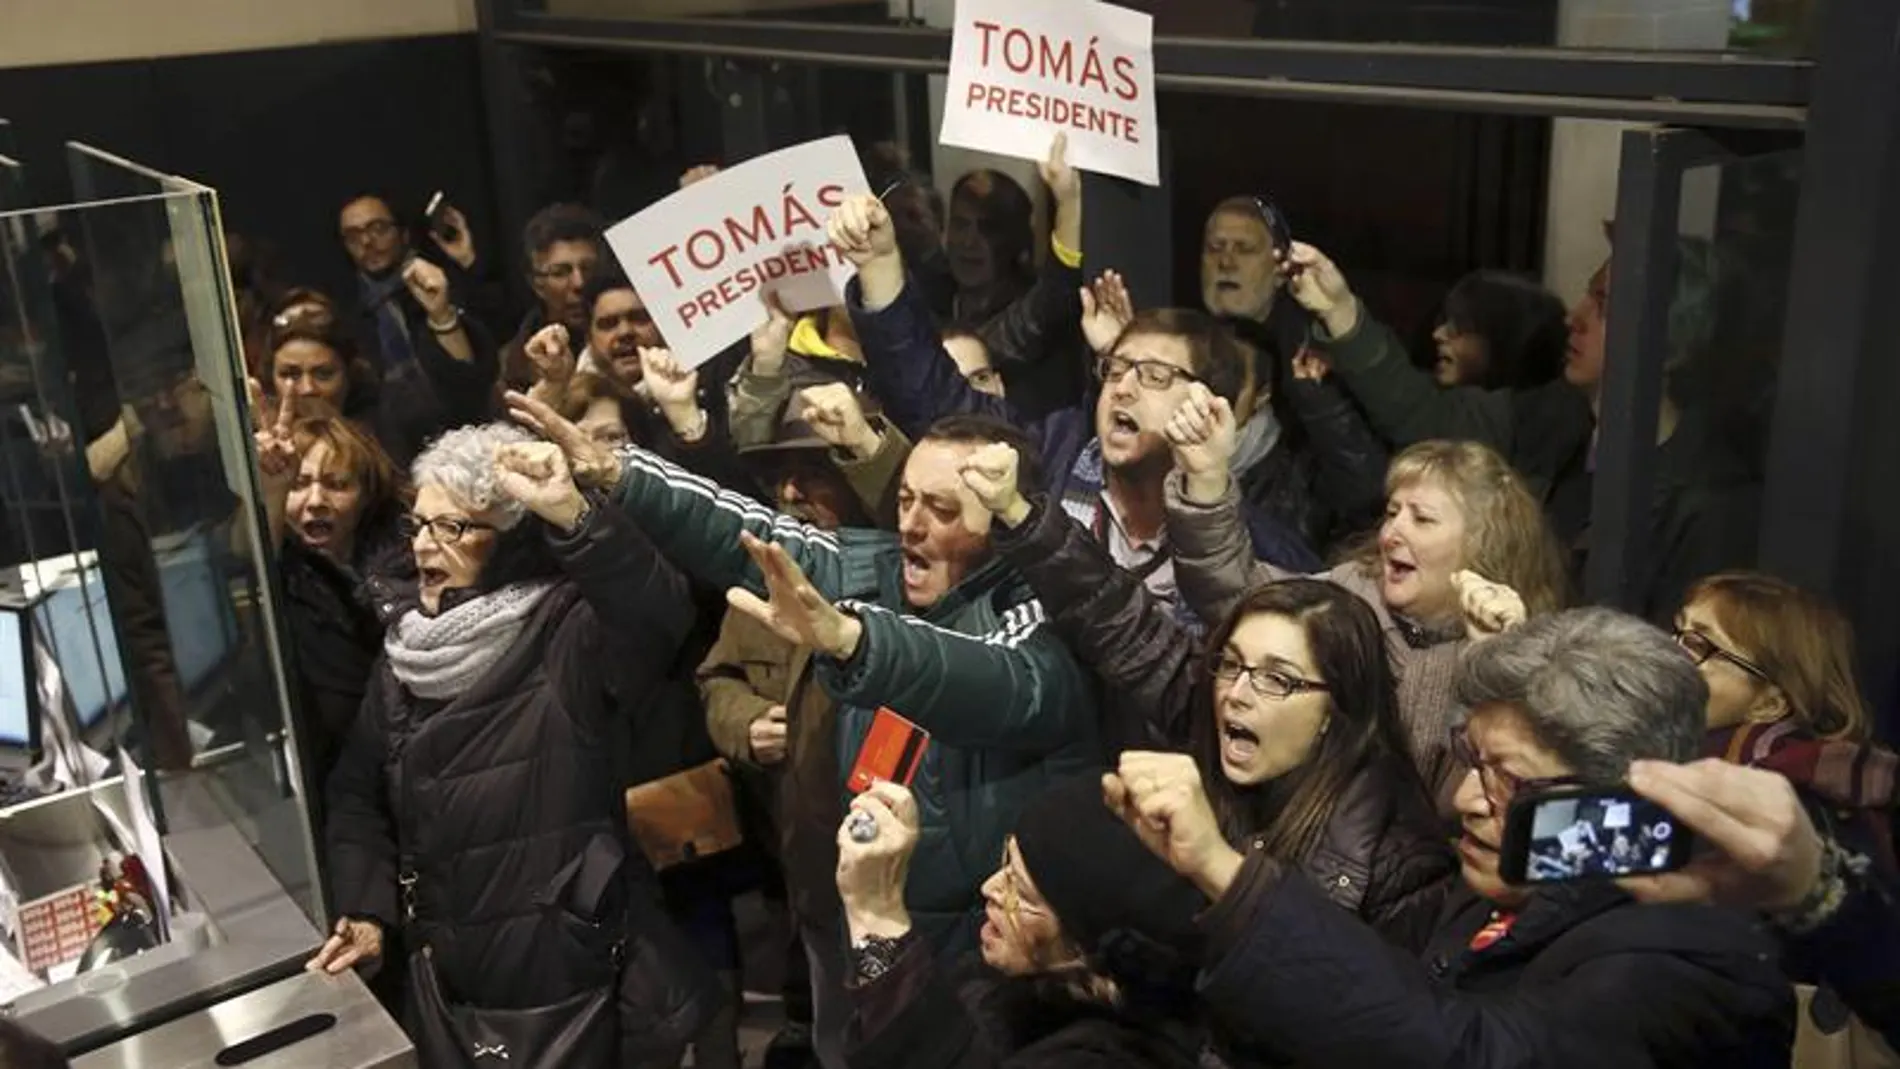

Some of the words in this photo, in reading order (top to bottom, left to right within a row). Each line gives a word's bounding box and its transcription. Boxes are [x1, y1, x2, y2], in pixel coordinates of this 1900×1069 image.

[974, 21, 1139, 101] TOMÁS
[966, 82, 1139, 144] PRESIDENTE
[677, 239, 846, 329] PRESIDENT
